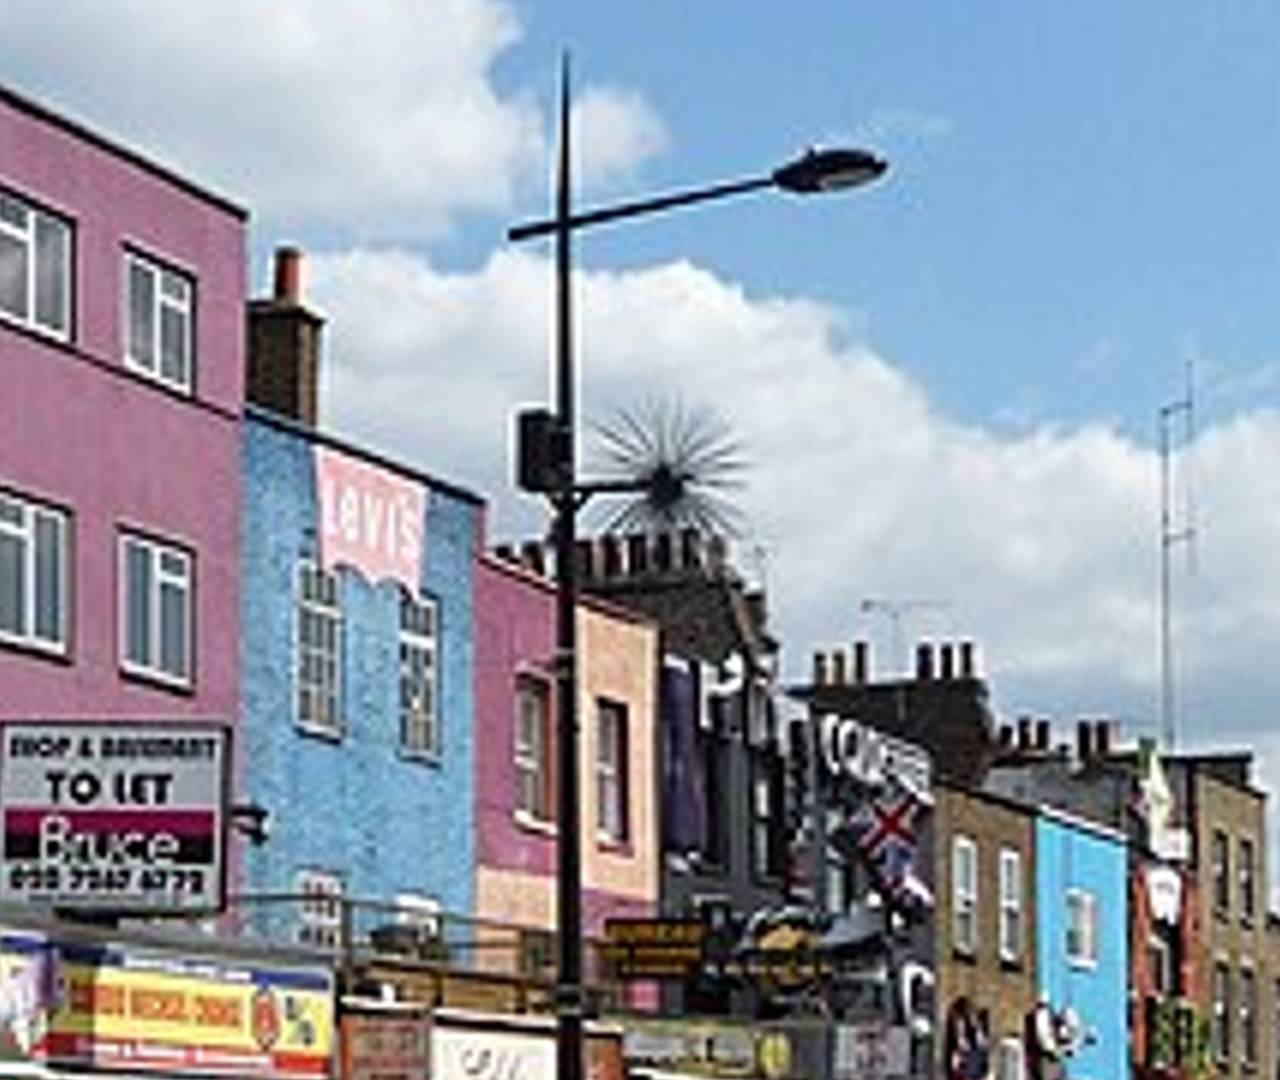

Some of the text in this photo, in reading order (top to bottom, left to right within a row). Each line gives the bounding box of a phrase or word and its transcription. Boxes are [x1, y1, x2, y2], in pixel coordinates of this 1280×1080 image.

[9, 737, 71, 759] SHOP
[78, 737, 95, 759] &
[45, 771, 174, 805] TO LET
[39, 815, 181, 863] Bruce
